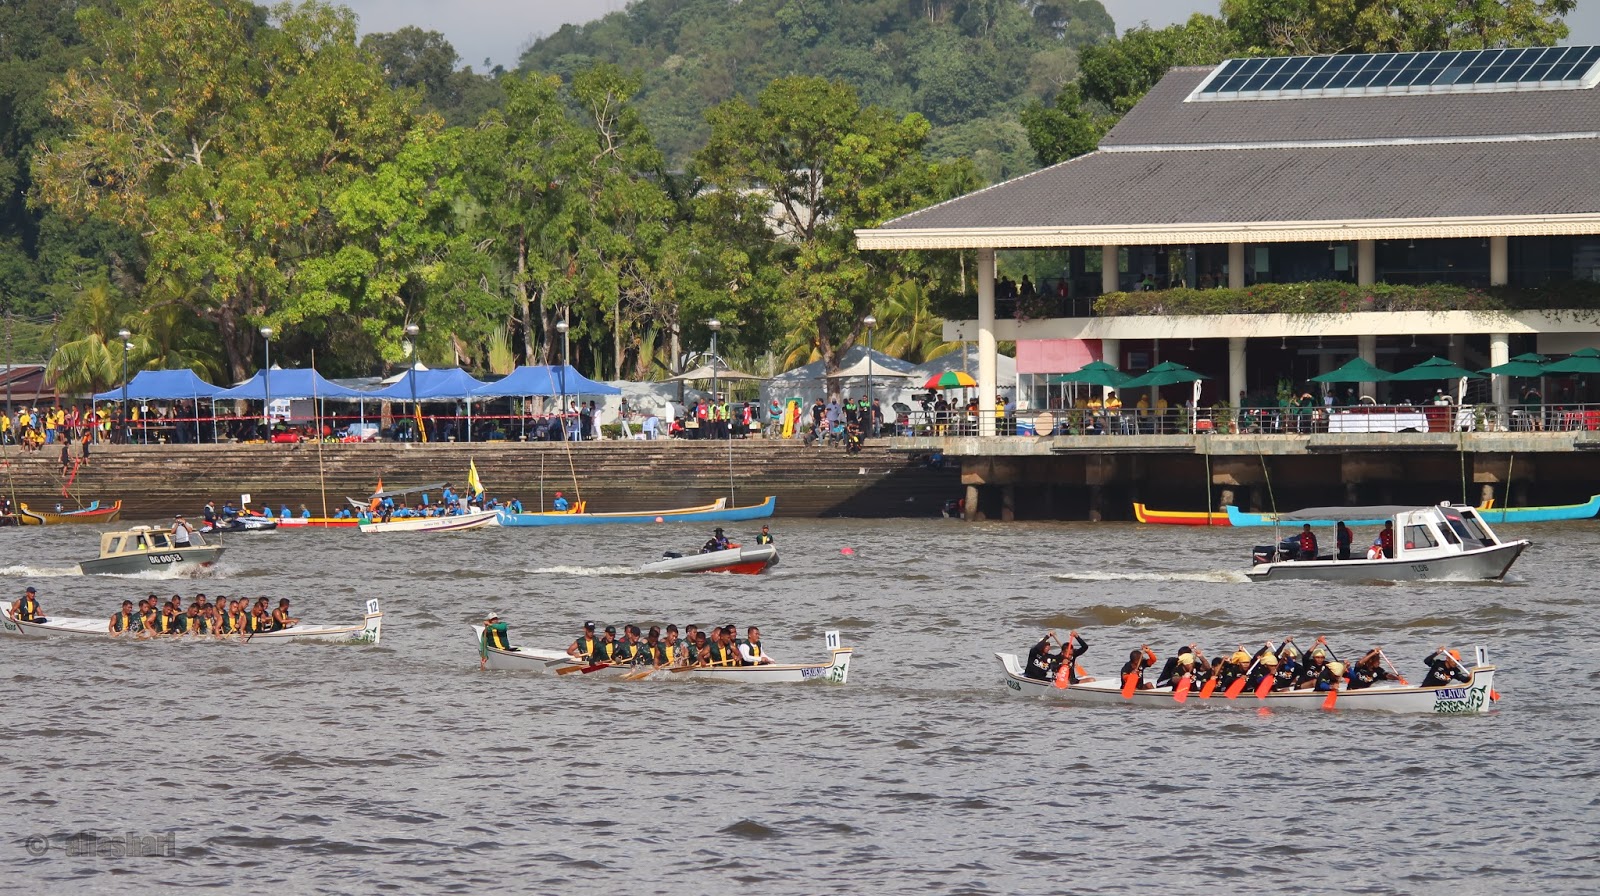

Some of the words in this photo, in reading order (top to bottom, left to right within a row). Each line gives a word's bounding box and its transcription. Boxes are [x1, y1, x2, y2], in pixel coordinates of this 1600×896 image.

[148, 555, 161, 564] BG
[160, 553, 182, 563] 0053
[369, 600, 378, 613] 12
[827, 633, 837, 647] 11
[1480, 648, 1485, 664] 1
[1435, 689, 1467, 700] JELATUK
